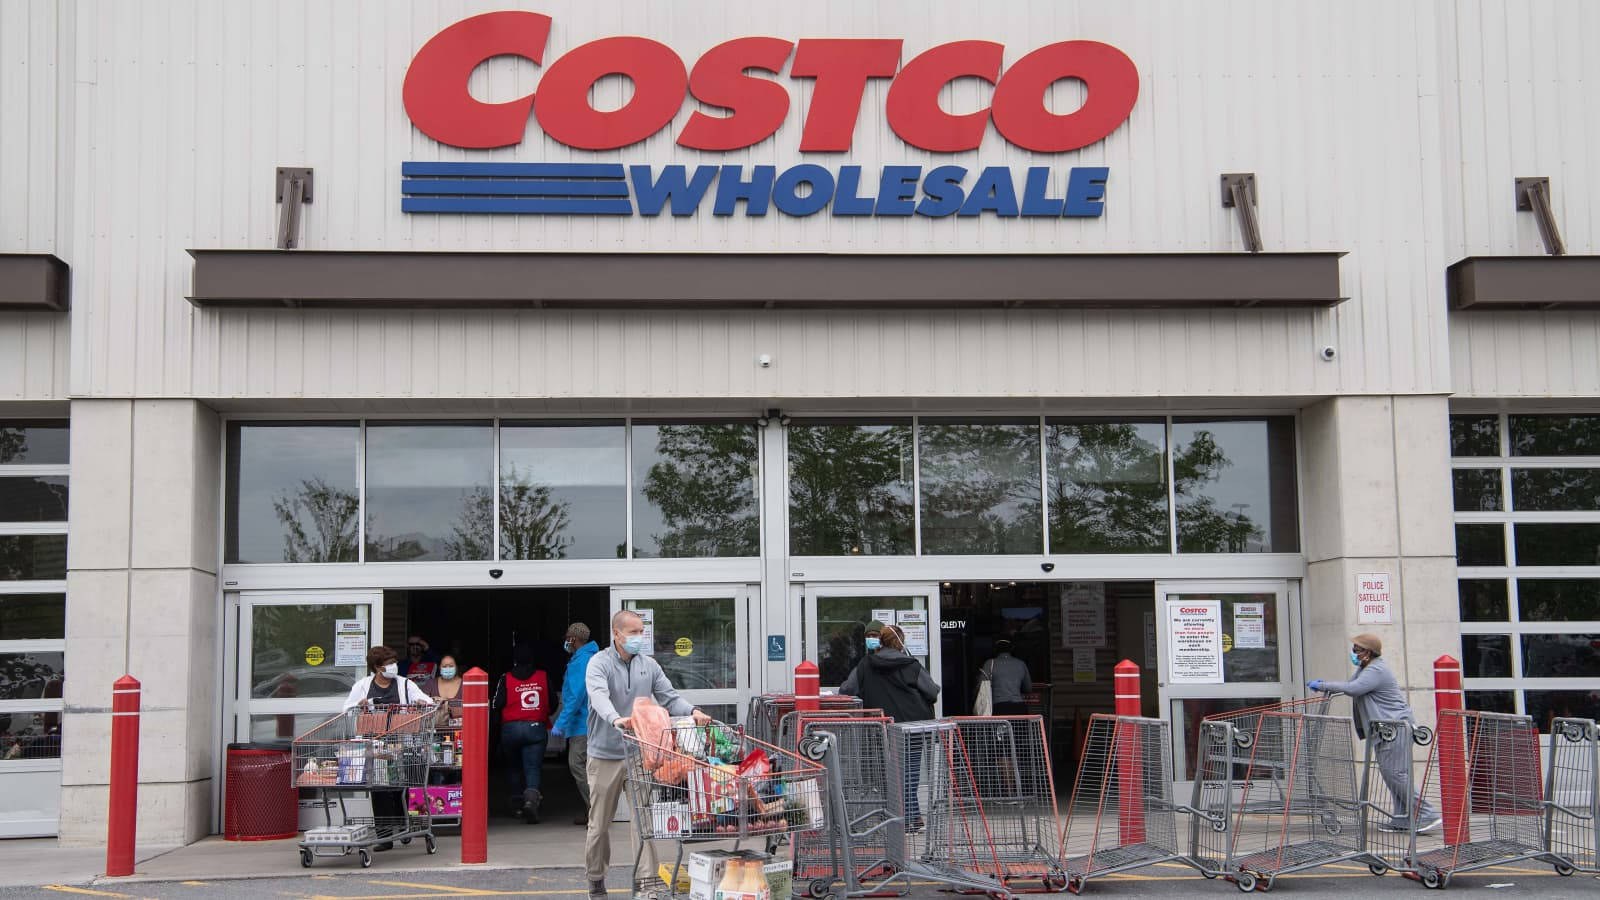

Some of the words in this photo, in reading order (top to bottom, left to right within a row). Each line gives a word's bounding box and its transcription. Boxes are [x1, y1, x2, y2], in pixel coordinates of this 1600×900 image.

[403, 11, 1139, 153] COSTCO
[629, 163, 1109, 218] WHOLESALE
[1362, 581, 1384, 589] POLICE
[1358, 593, 1390, 601] SATELLITE
[1364, 605, 1384, 613] OFFICE
[940, 620, 957, 629] QLED
[957, 620, 966, 629] TV
